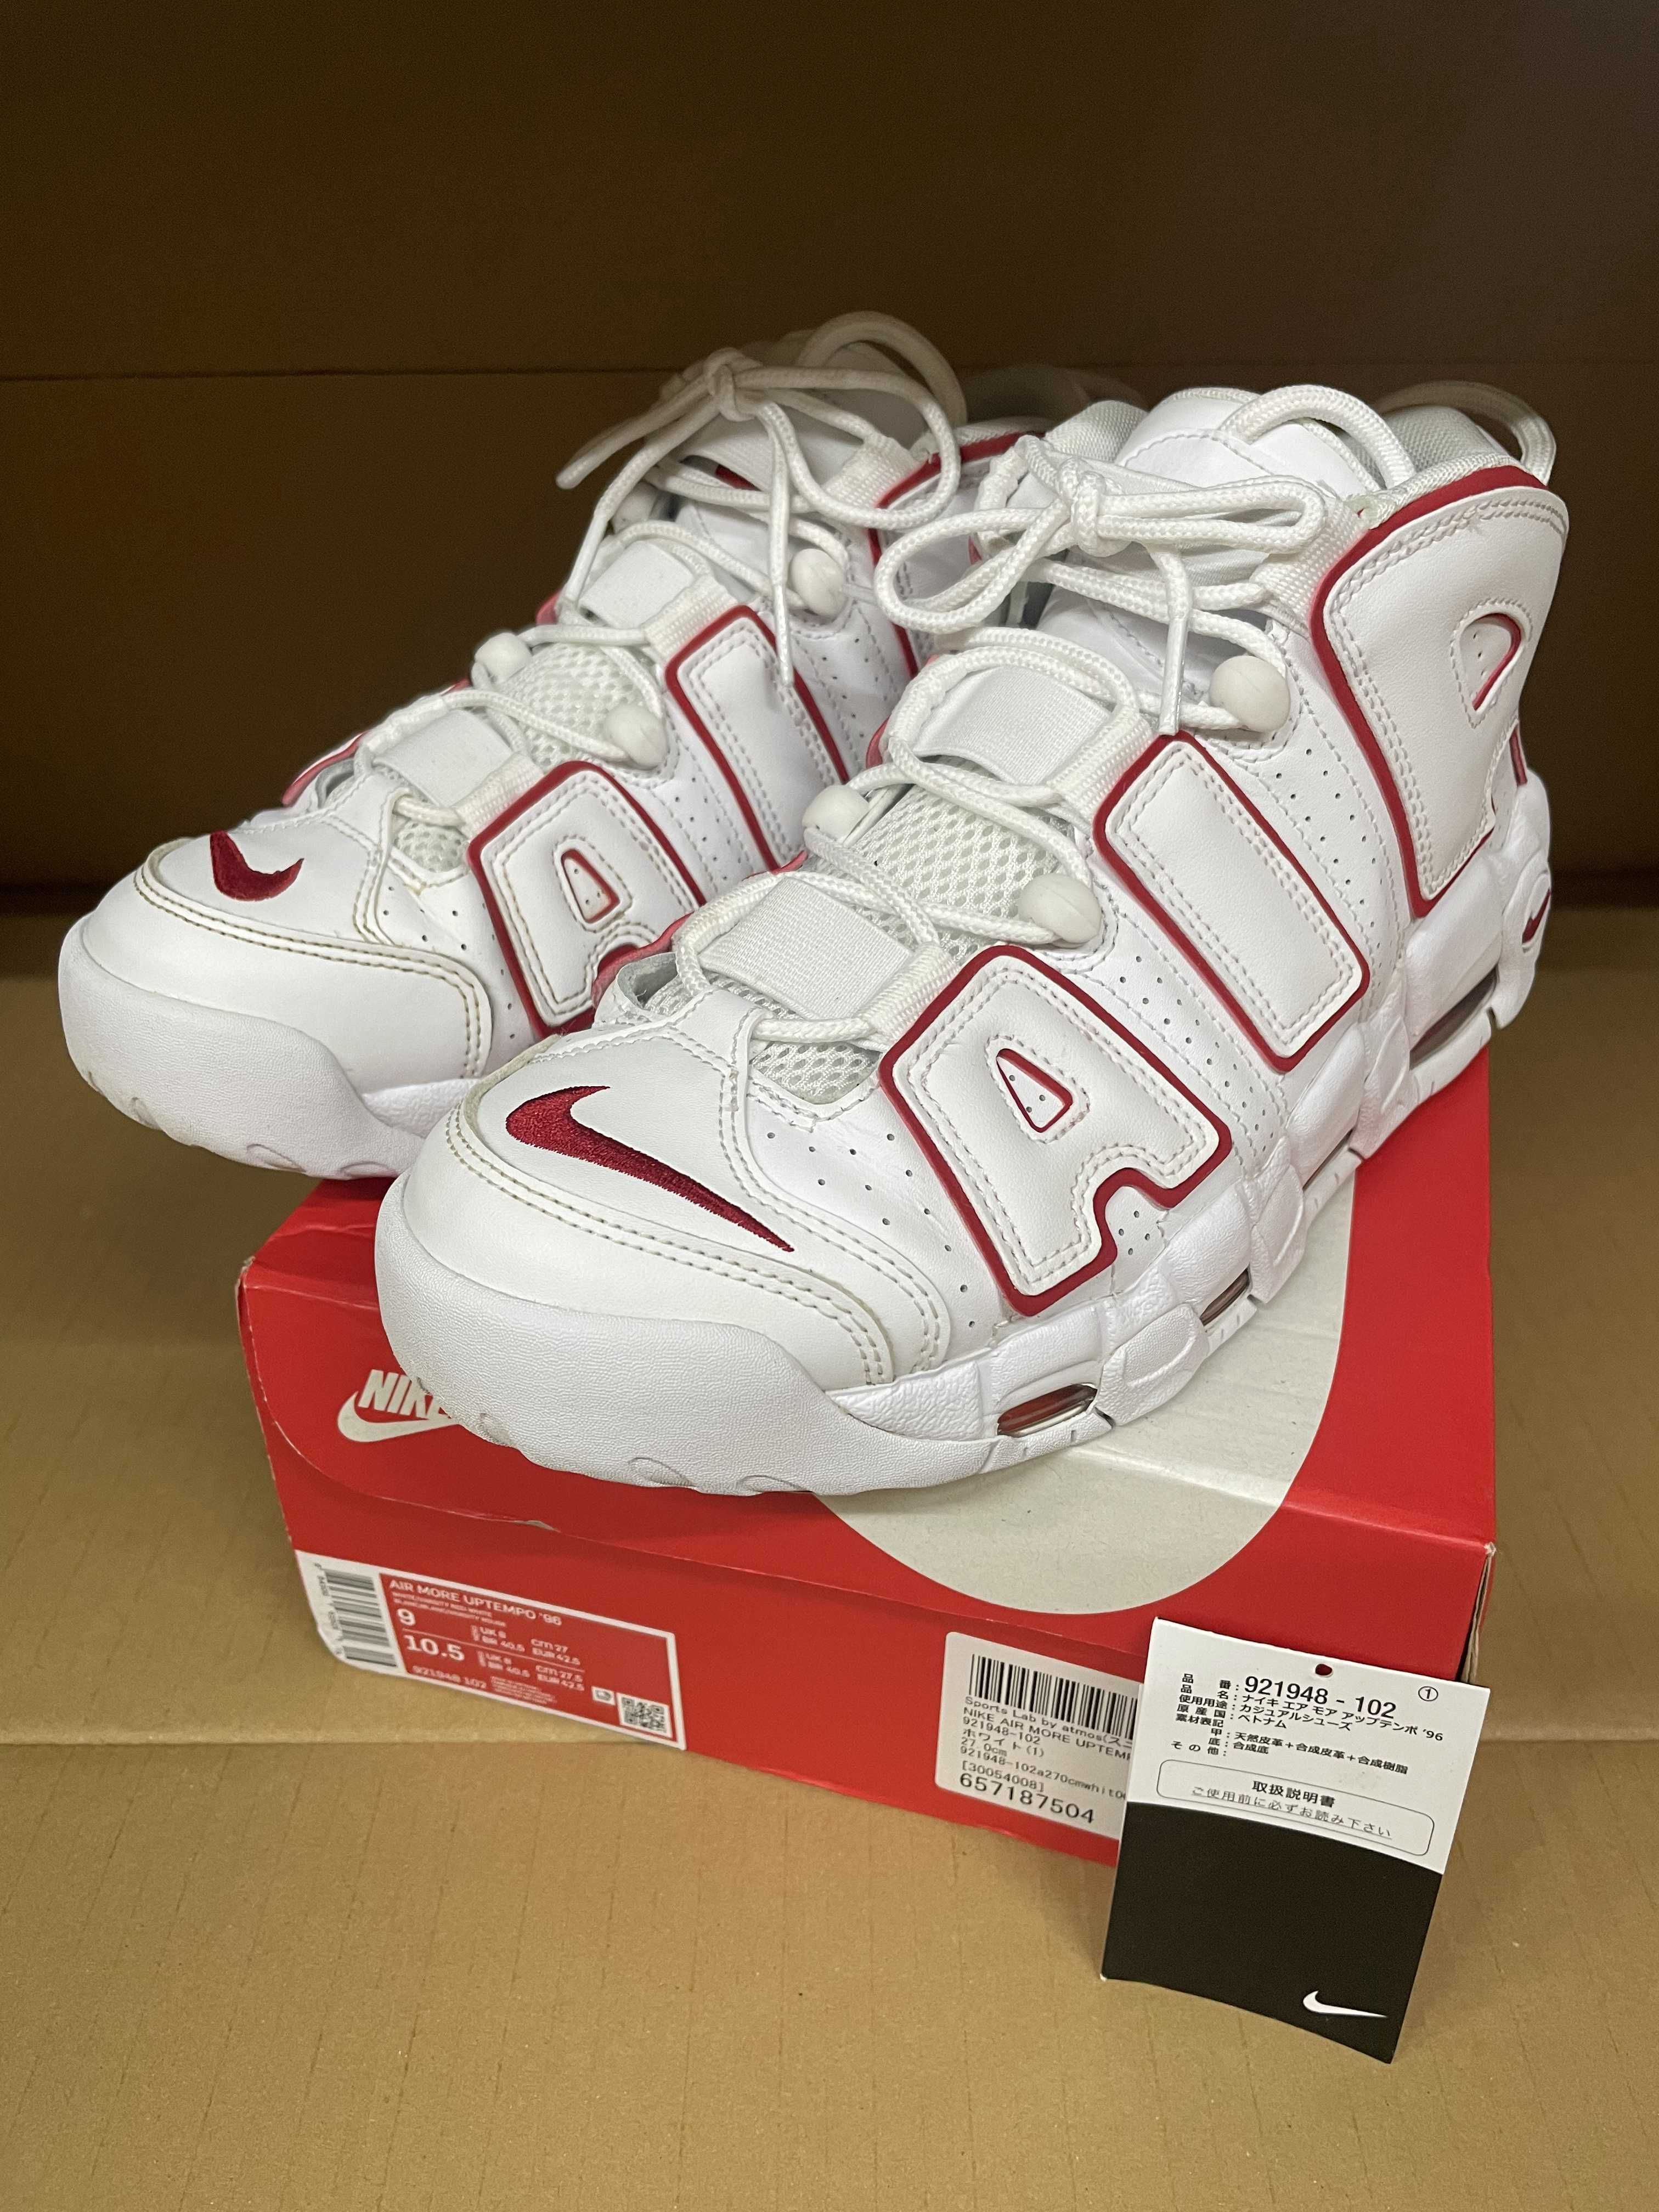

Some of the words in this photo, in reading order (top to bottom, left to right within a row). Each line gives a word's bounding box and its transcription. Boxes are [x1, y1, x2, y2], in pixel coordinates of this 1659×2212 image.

[390, 1580, 413, 1592] AIR
[416, 1584, 460, 1602] MORE
[464, 1595, 536, 1619] UPTEMPO
[397, 1608, 416, 1626] 9
[404, 1635, 465, 1661] 10.5
[1243, 1694, 1279, 1707] ナイキ
[1282, 1701, 1308, 1711] エア
[1312, 1706, 1338, 1717] モア
[1244, 1675, 1328, 1705] 921948
[1355, 1696, 1397, 1719] 102
[964, 1707, 994, 1722] NIKE
[1001, 1718, 1023, 1730] AIR
[1029, 1725, 1070, 1743] MORE
[966, 1696, 1007, 1714] Sports
[1013, 1710, 1036, 1722] Lab
[1042, 1717, 1057, 1728] by
[1176, 1713, 1224, 1728] 素材表記
[1238, 1714, 1286, 1729] ベトナム
[963, 1717, 1040, 1745] 921948-102
[1233, 1741, 1269, 1754] 合成底
[960, 1773, 1094, 1824] 657187504
[1252, 1780, 1336, 1808] 取扱説明書
